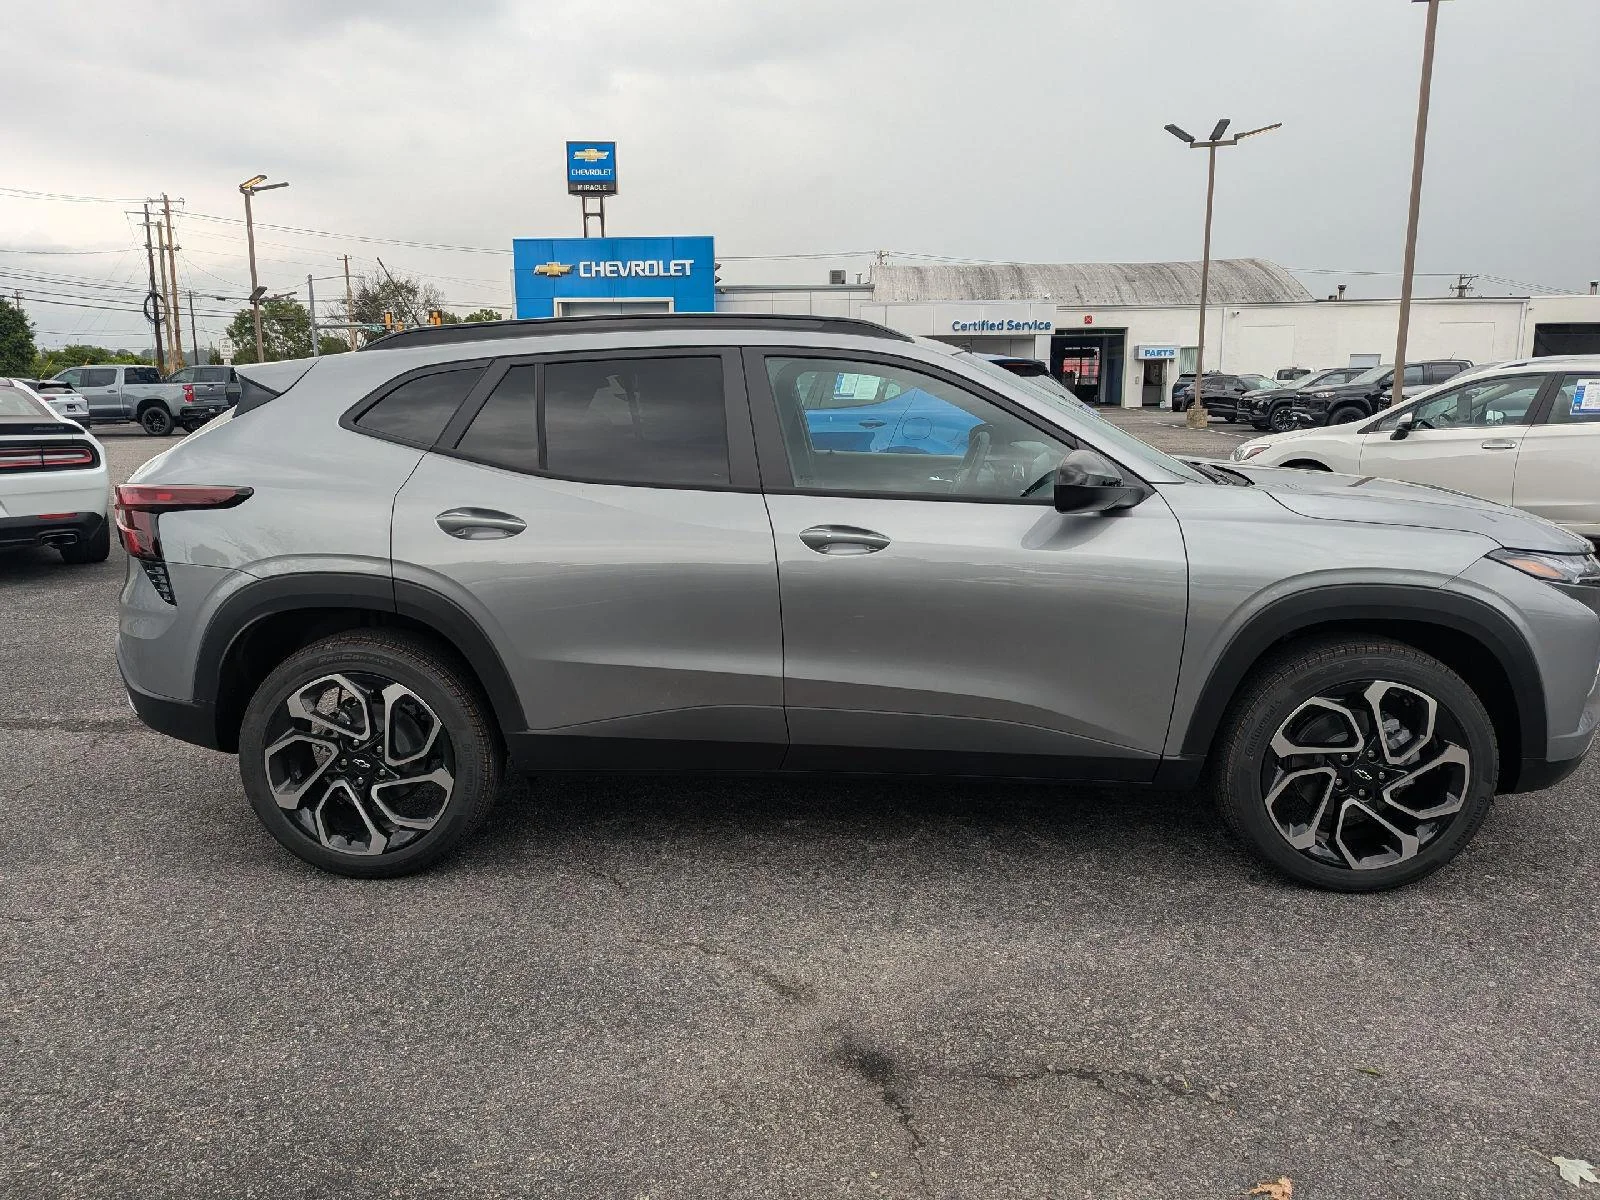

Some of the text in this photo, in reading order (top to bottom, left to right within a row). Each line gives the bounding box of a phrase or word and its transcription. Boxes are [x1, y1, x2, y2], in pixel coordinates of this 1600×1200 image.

[571, 168, 612, 176] CHEVROLET
[579, 260, 694, 277] CHEVROLET
[952, 320, 1051, 331] Certified Service
[1144, 349, 1174, 357] PARTS
